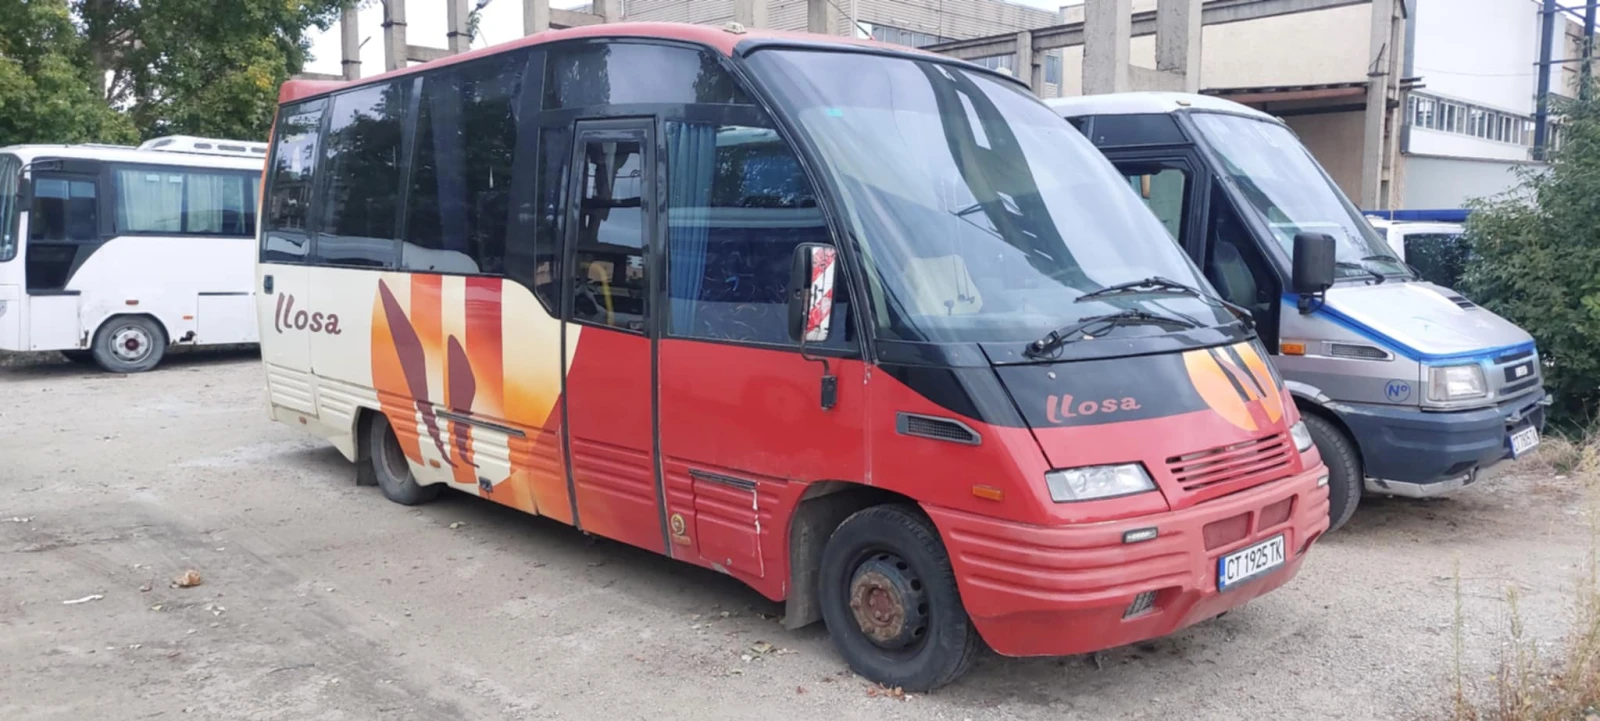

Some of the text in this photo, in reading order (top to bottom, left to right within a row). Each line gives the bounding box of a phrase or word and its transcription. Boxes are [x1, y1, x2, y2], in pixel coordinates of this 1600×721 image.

[1227, 539, 1283, 580] CT 1925 TK
